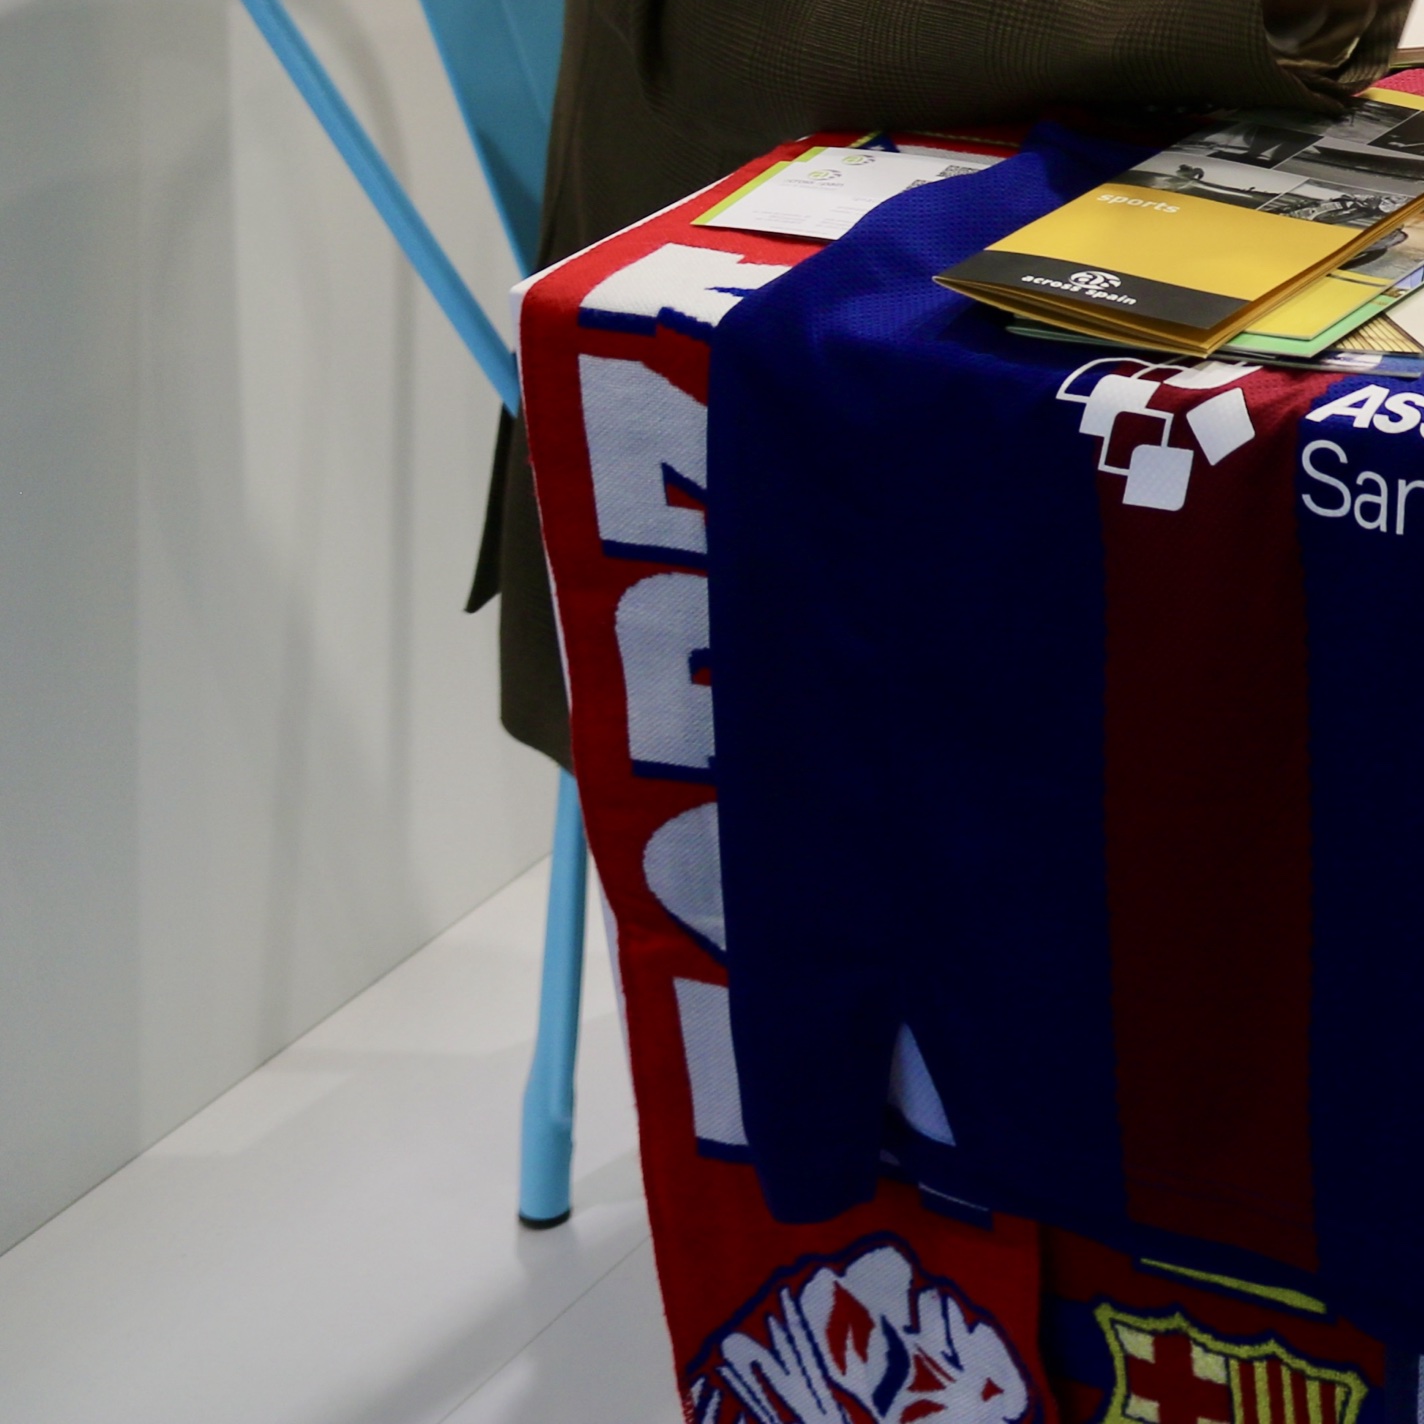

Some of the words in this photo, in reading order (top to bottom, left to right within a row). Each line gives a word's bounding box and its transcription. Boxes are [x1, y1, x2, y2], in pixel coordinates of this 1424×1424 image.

[1096, 193, 1181, 214] sports
[1021, 274, 1082, 293] across
[1084, 287, 1138, 306] spain
